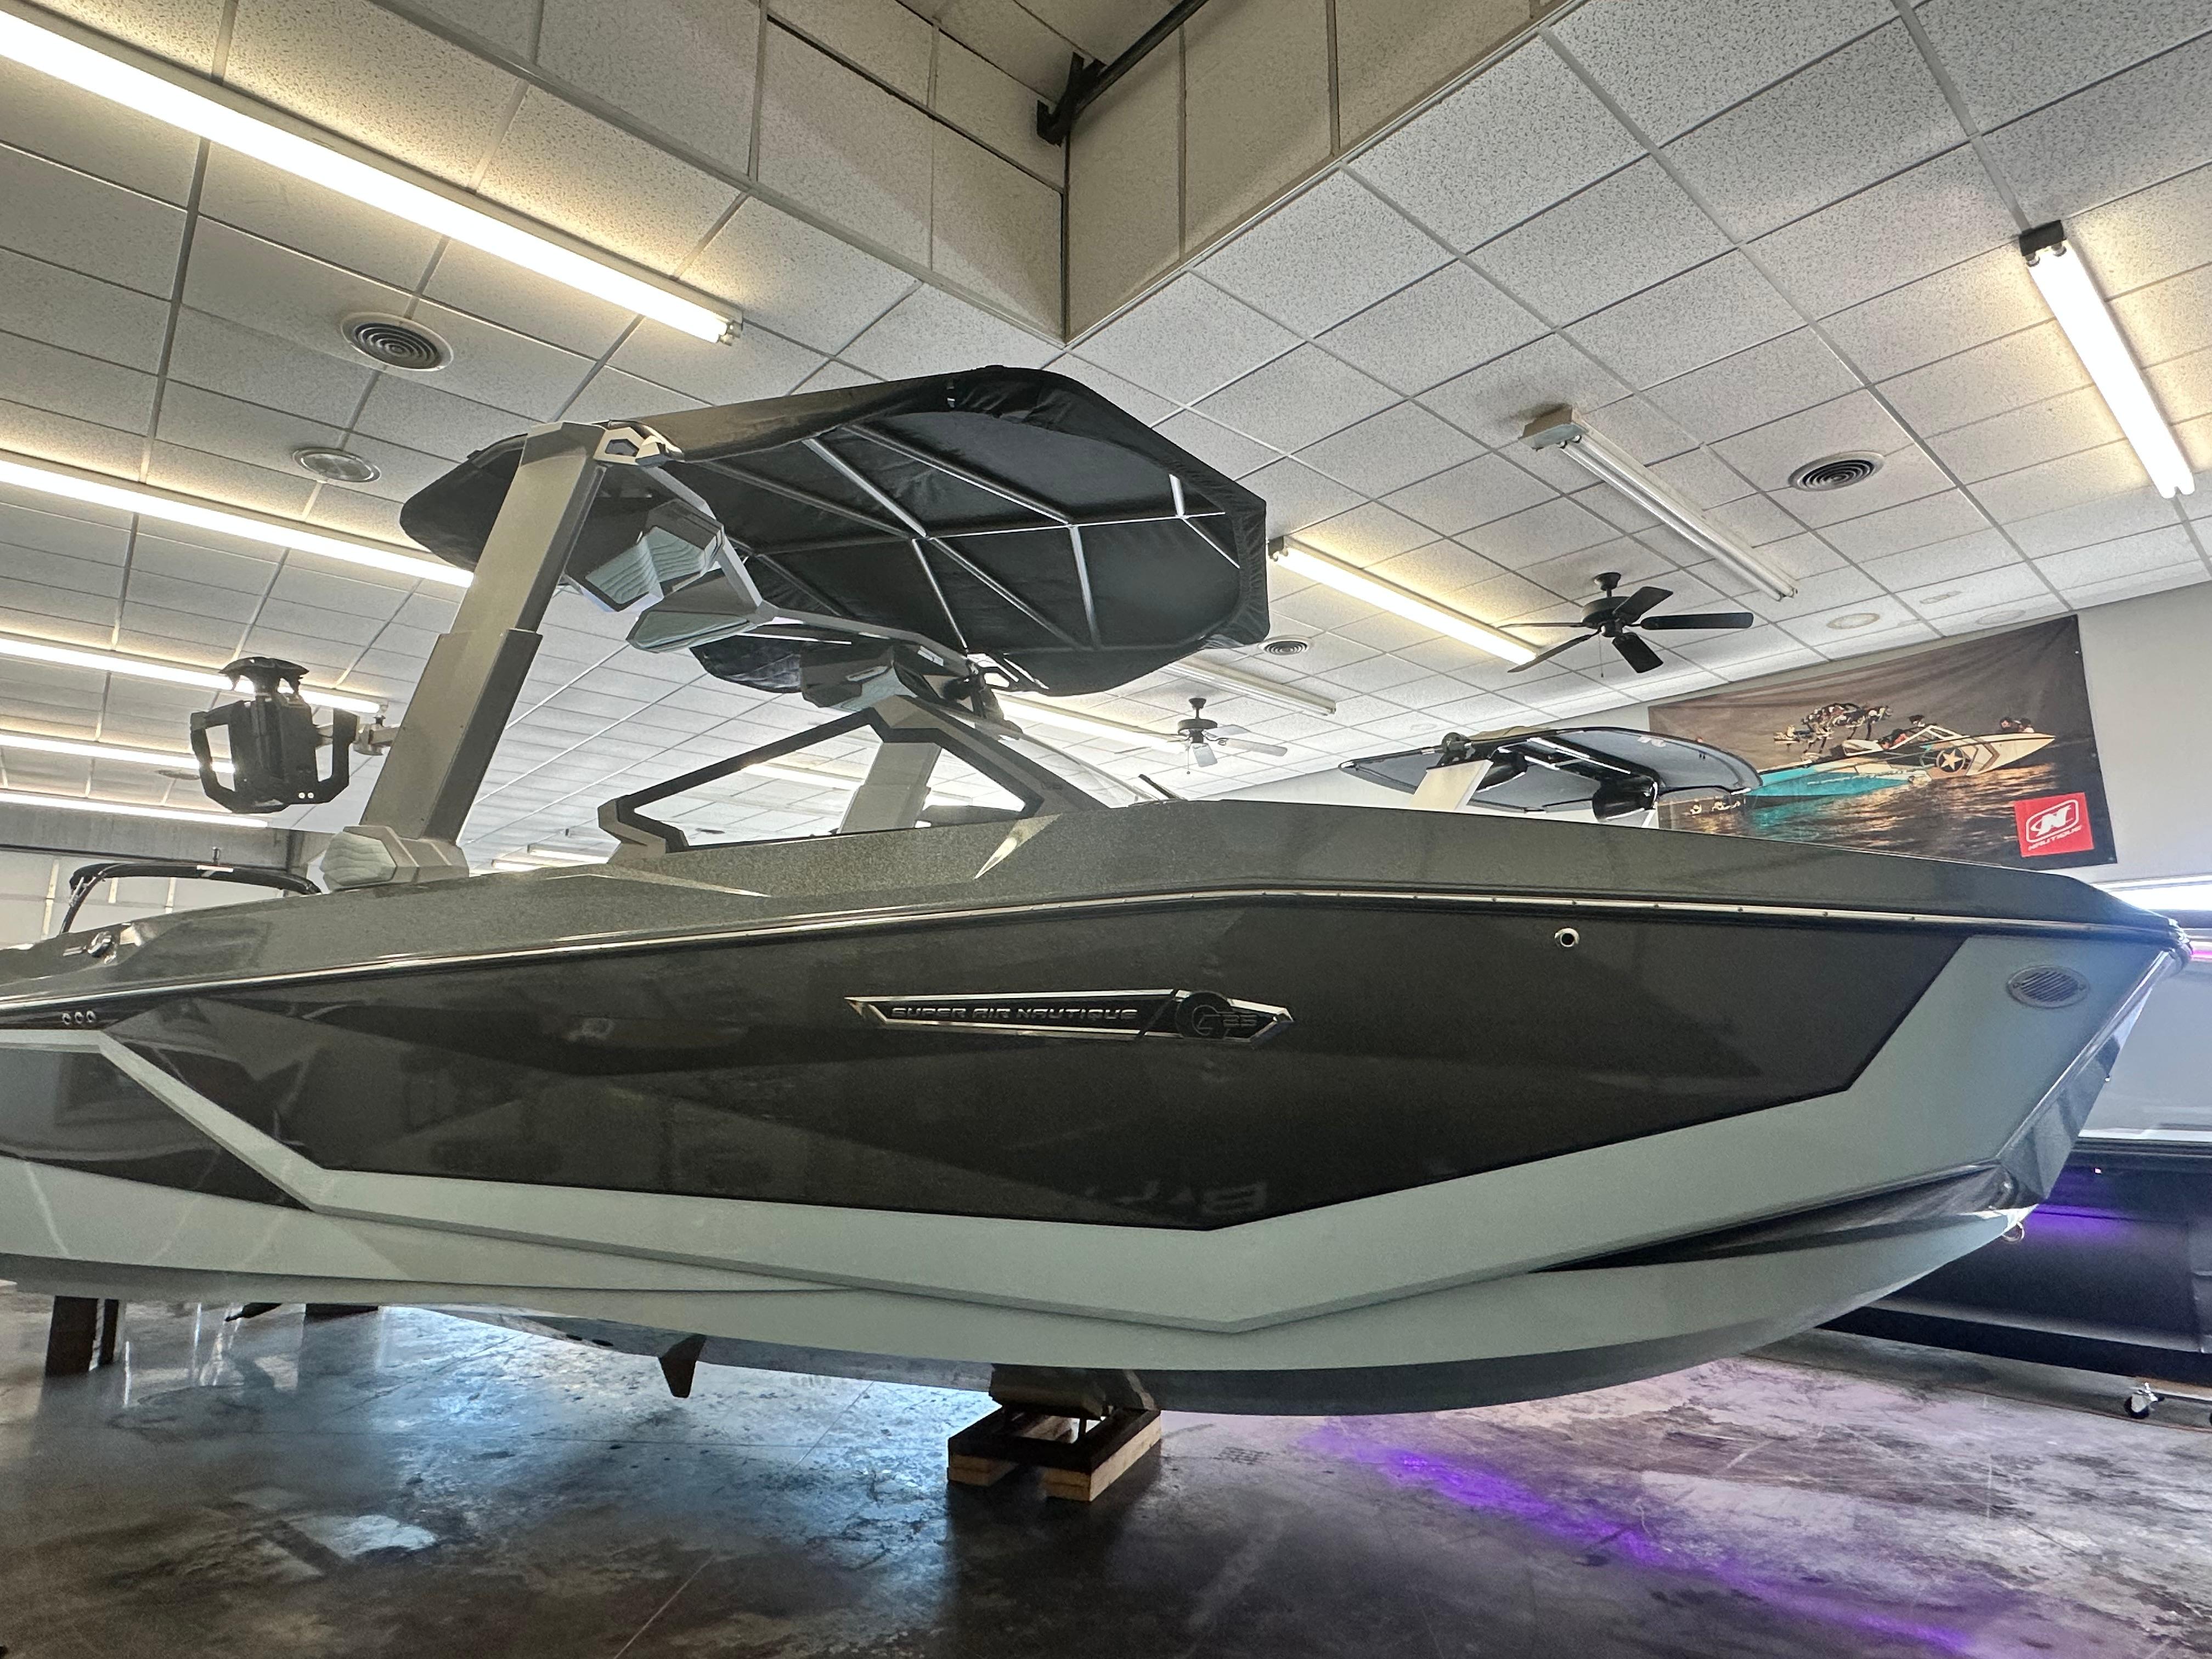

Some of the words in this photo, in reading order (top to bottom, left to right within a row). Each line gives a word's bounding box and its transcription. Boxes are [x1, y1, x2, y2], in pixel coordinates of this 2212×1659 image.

[891, 1007, 967, 1019] SUPER
[973, 1008, 1011, 1018] AIR
[1018, 1008, 1138, 1019] NAUTIQUE
